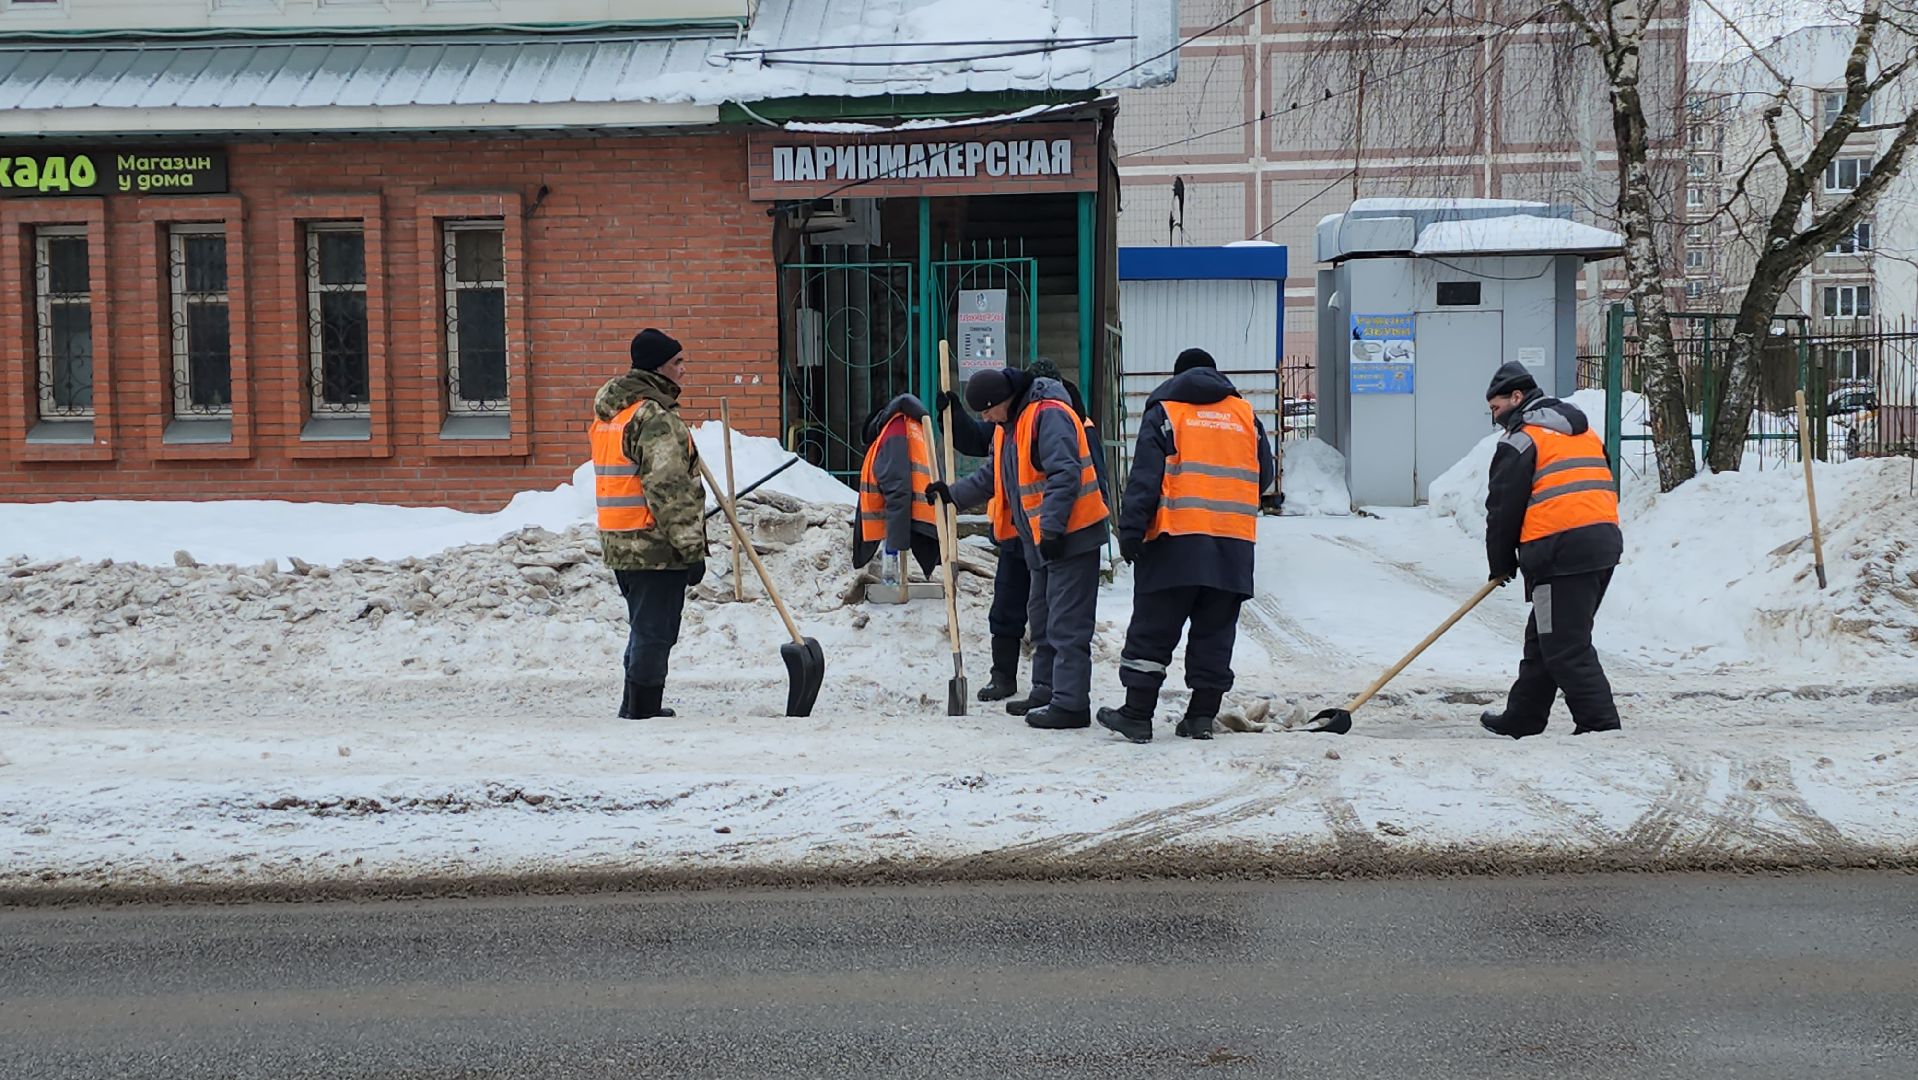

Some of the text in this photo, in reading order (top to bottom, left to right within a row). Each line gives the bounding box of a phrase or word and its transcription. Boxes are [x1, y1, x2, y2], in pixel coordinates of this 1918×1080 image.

[117, 154, 211, 172] Магазин
[772, 139, 1071, 182] ПАРИКМАХЕРСКАЯ
[118, 172, 193, 191] у дома
